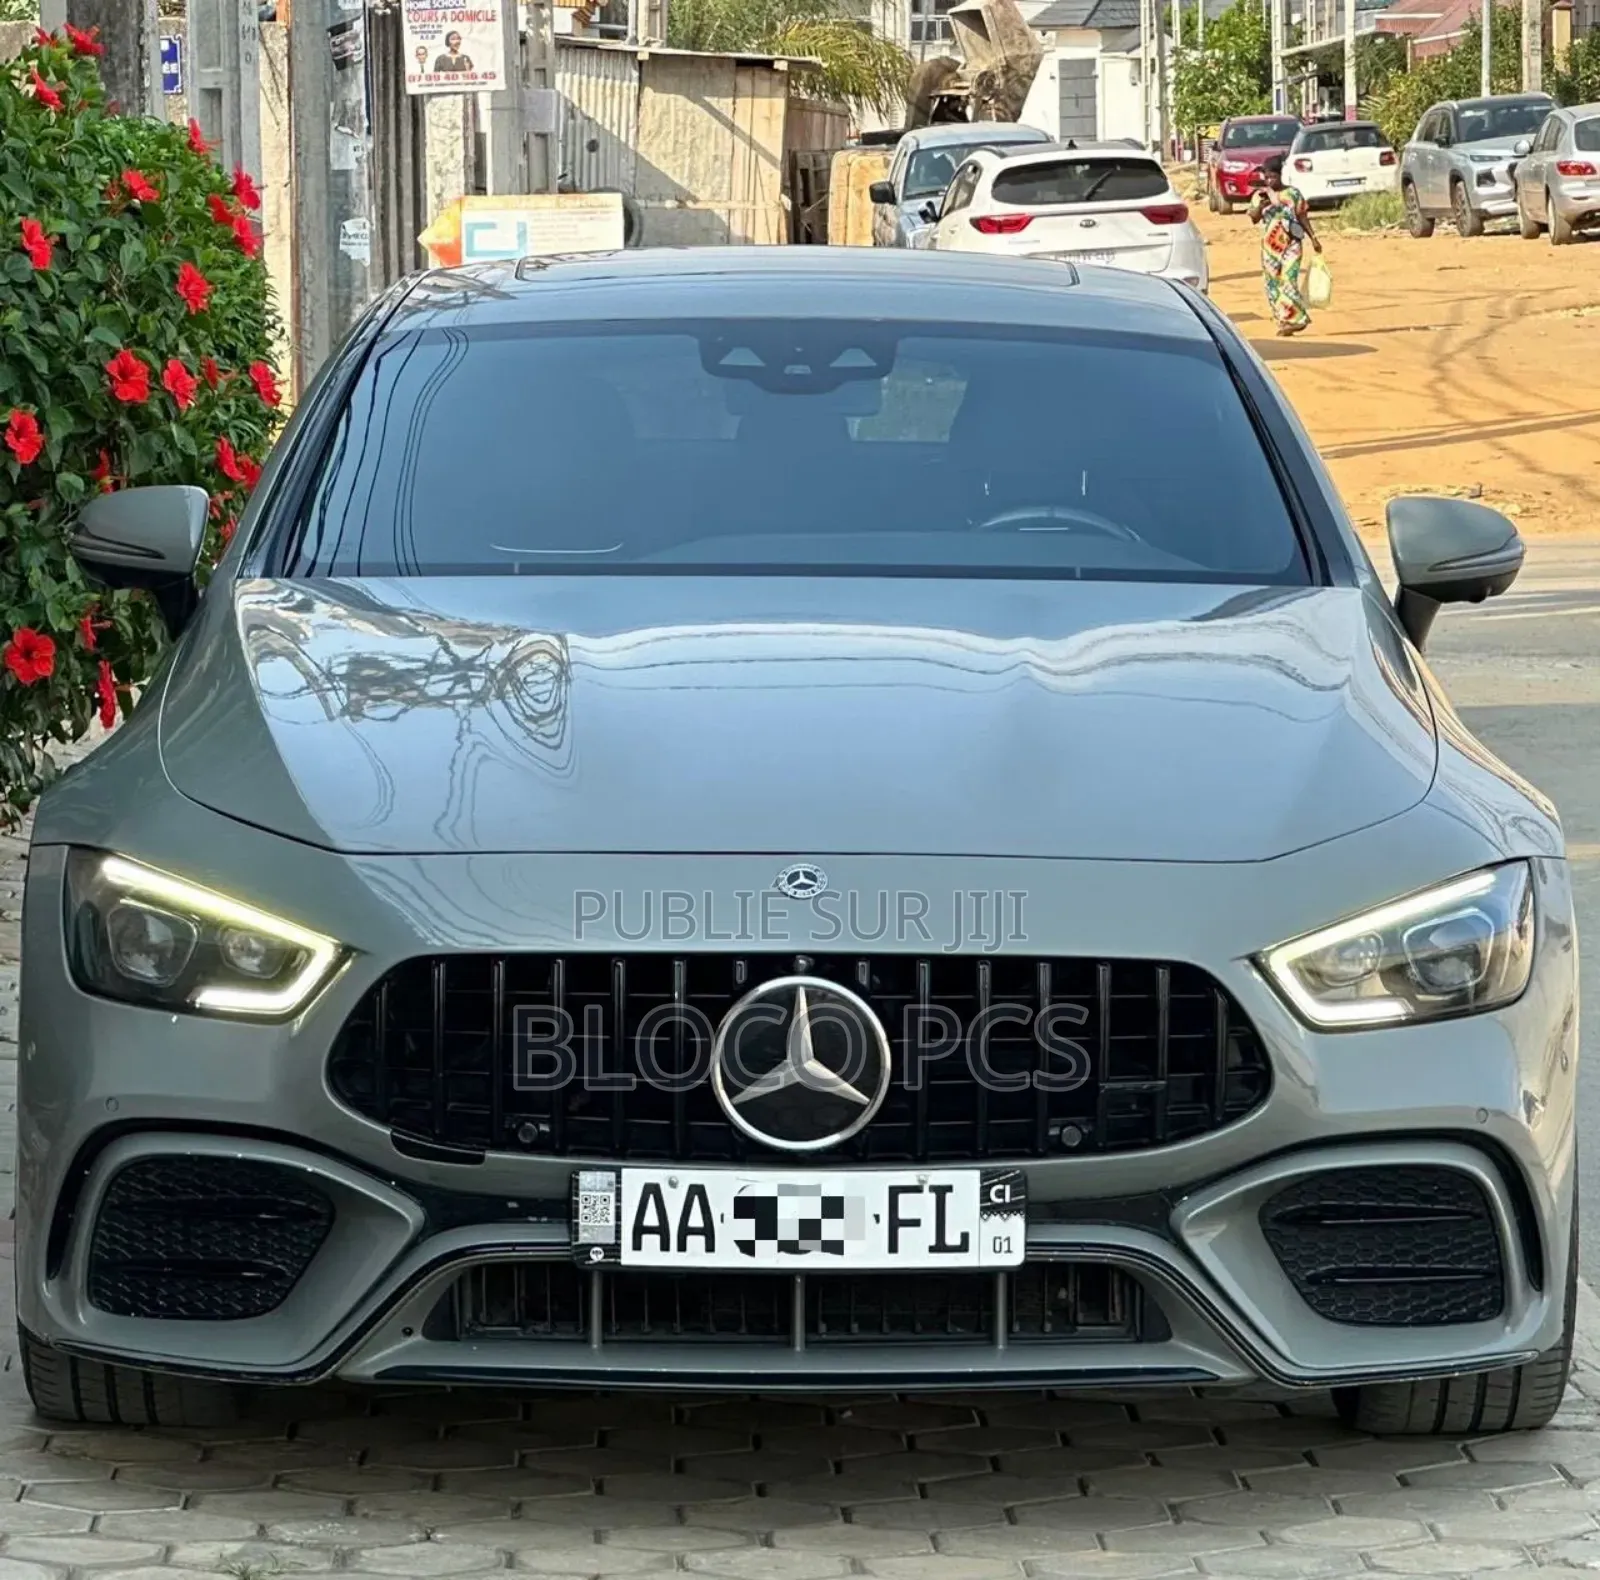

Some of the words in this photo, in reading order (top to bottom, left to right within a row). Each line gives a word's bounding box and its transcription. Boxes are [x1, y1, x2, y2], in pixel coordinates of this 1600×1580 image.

[407, 10, 439, 23] COURS
[441, 11, 448, 22] A
[451, 9, 497, 22] DOMICILE
[990, 1184, 1011, 1203] CI
[993, 1236, 1013, 1254] 01
